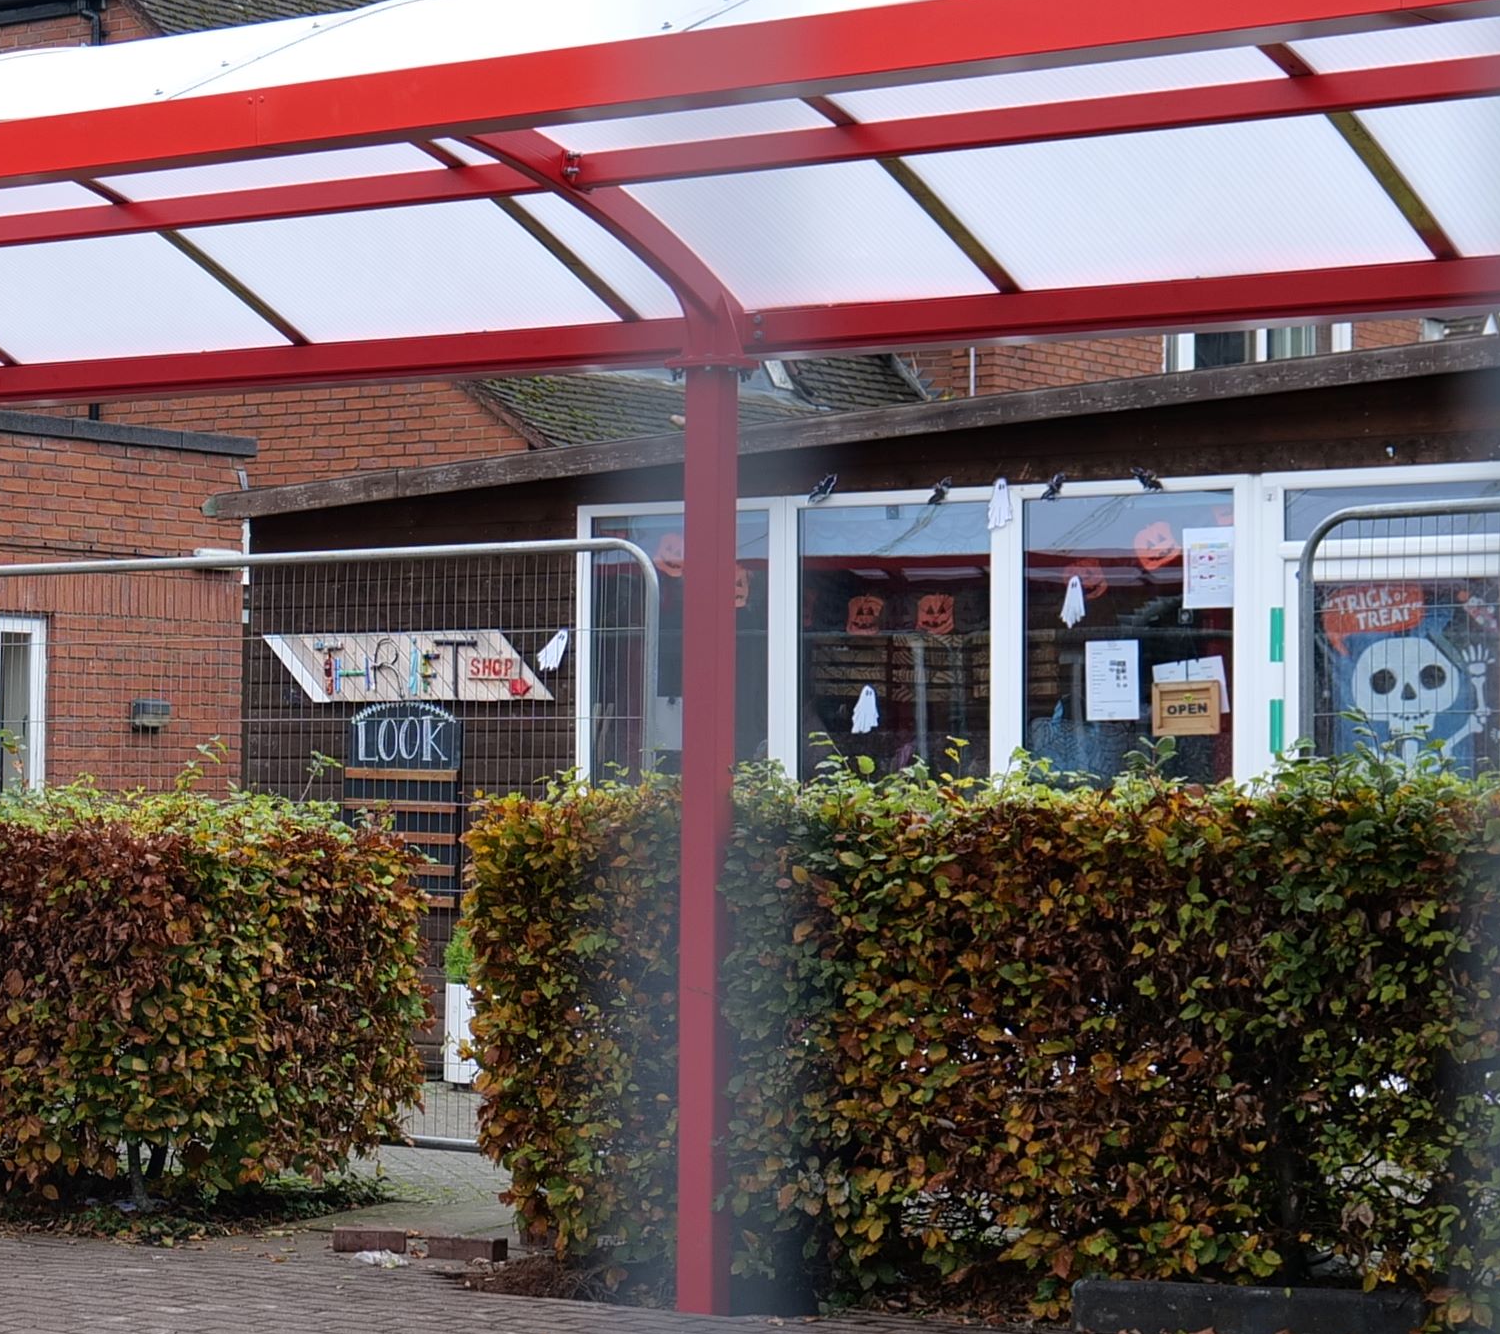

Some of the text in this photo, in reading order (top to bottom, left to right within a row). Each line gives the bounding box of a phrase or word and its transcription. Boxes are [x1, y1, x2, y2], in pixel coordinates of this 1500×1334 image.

[312, 636, 514, 699] THRIFT SHOP
[1167, 702, 1208, 715] OPEN
[357, 715, 449, 762] LOOK
